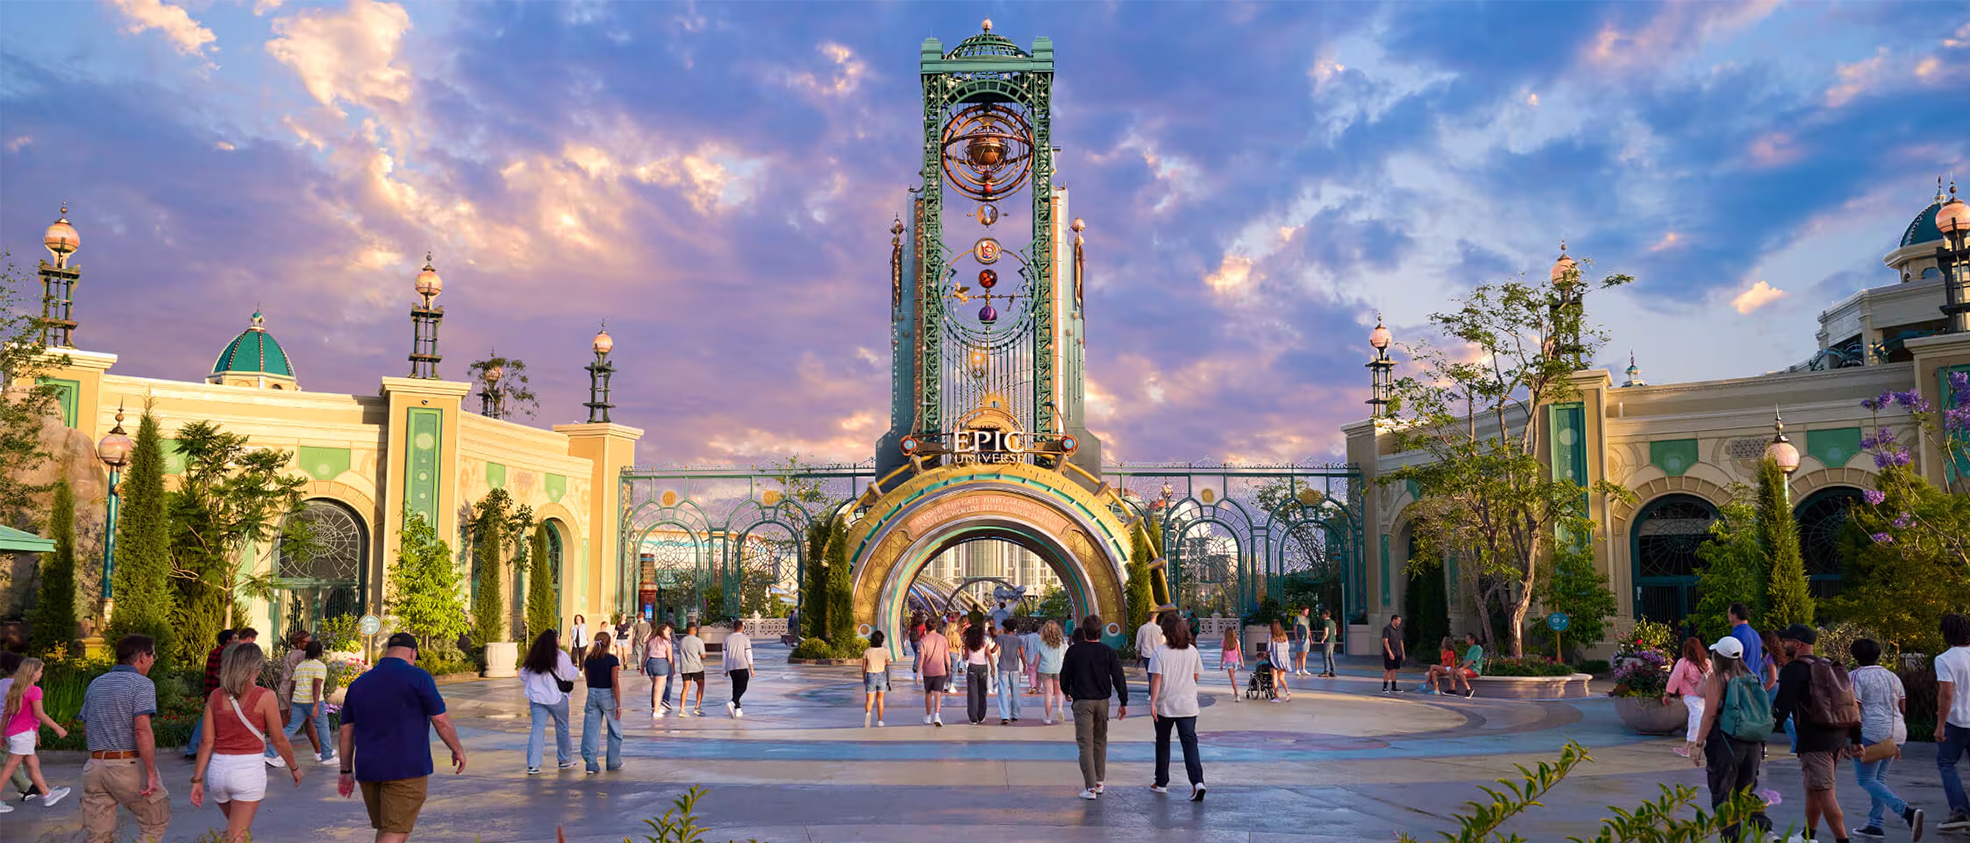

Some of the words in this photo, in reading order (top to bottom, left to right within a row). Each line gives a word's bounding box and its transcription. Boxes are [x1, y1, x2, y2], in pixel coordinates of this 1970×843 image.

[953, 431, 1024, 453] EPIC
[954, 453, 1025, 464] UNIVERSE
[950, 504, 979, 516] WORLDS
